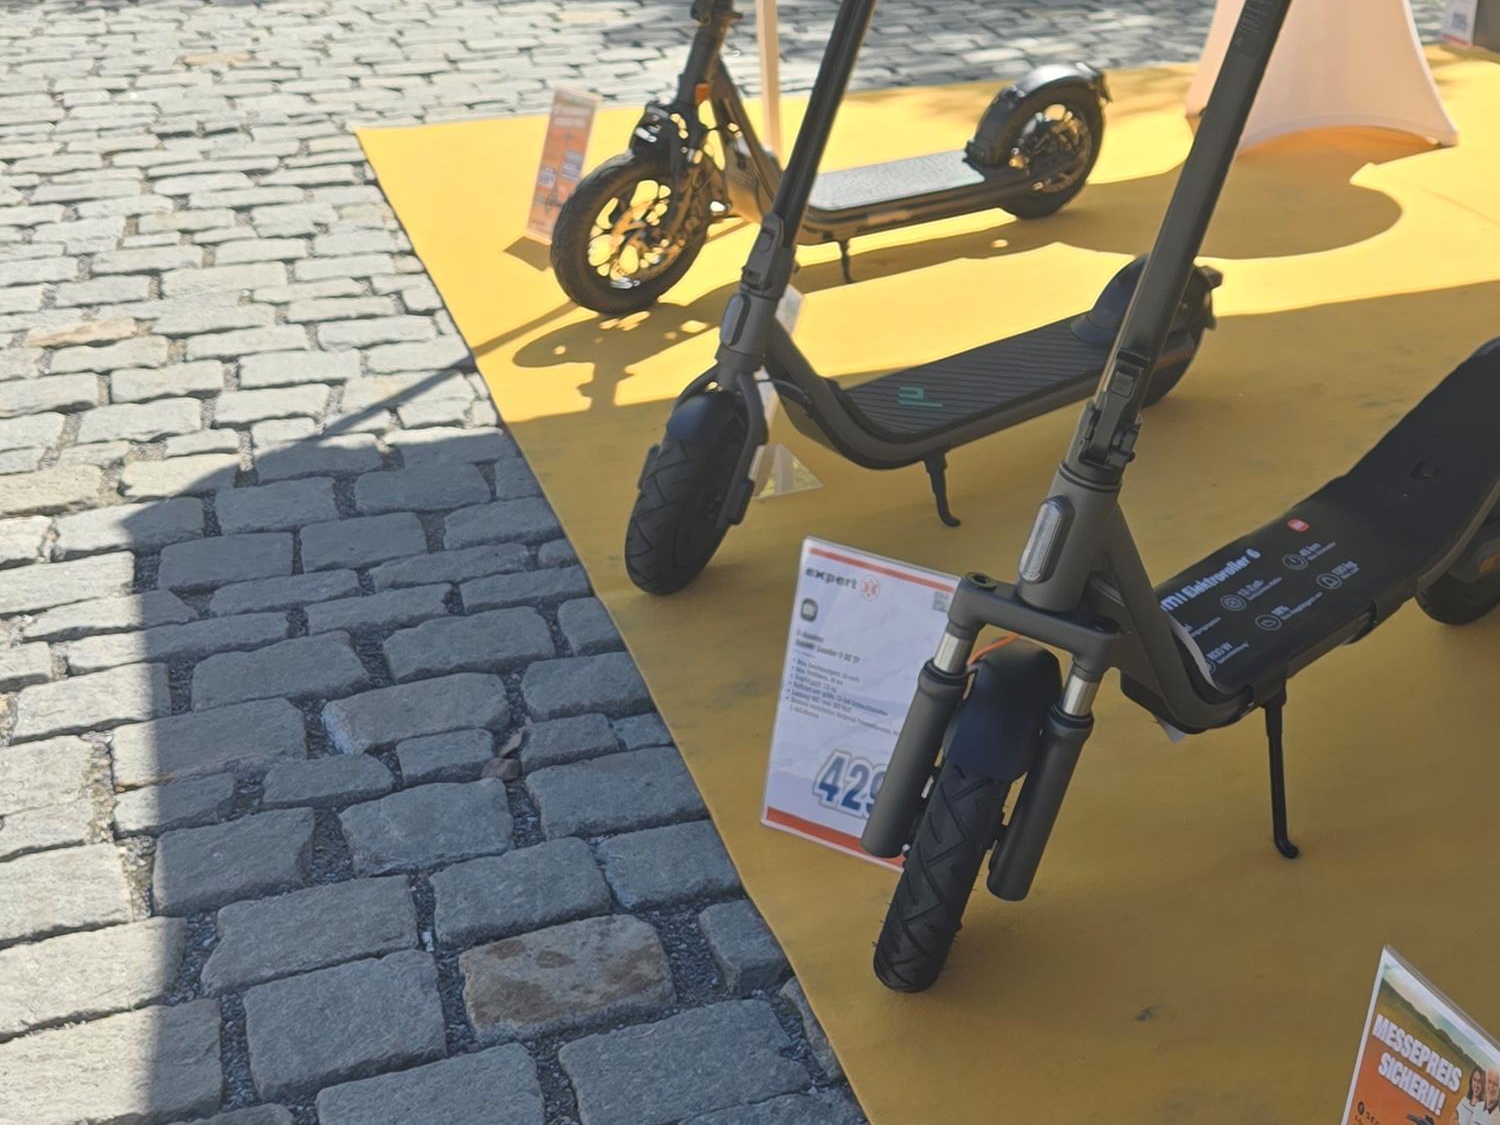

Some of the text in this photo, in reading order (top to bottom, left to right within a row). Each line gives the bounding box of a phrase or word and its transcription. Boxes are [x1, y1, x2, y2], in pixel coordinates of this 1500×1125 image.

[805, 566, 858, 589] expert
[1181, 555, 1250, 599] Elektroroller
[1372, 1013, 1462, 1092] MESSEPREIS
[1378, 1052, 1446, 1116] SICHERN!
